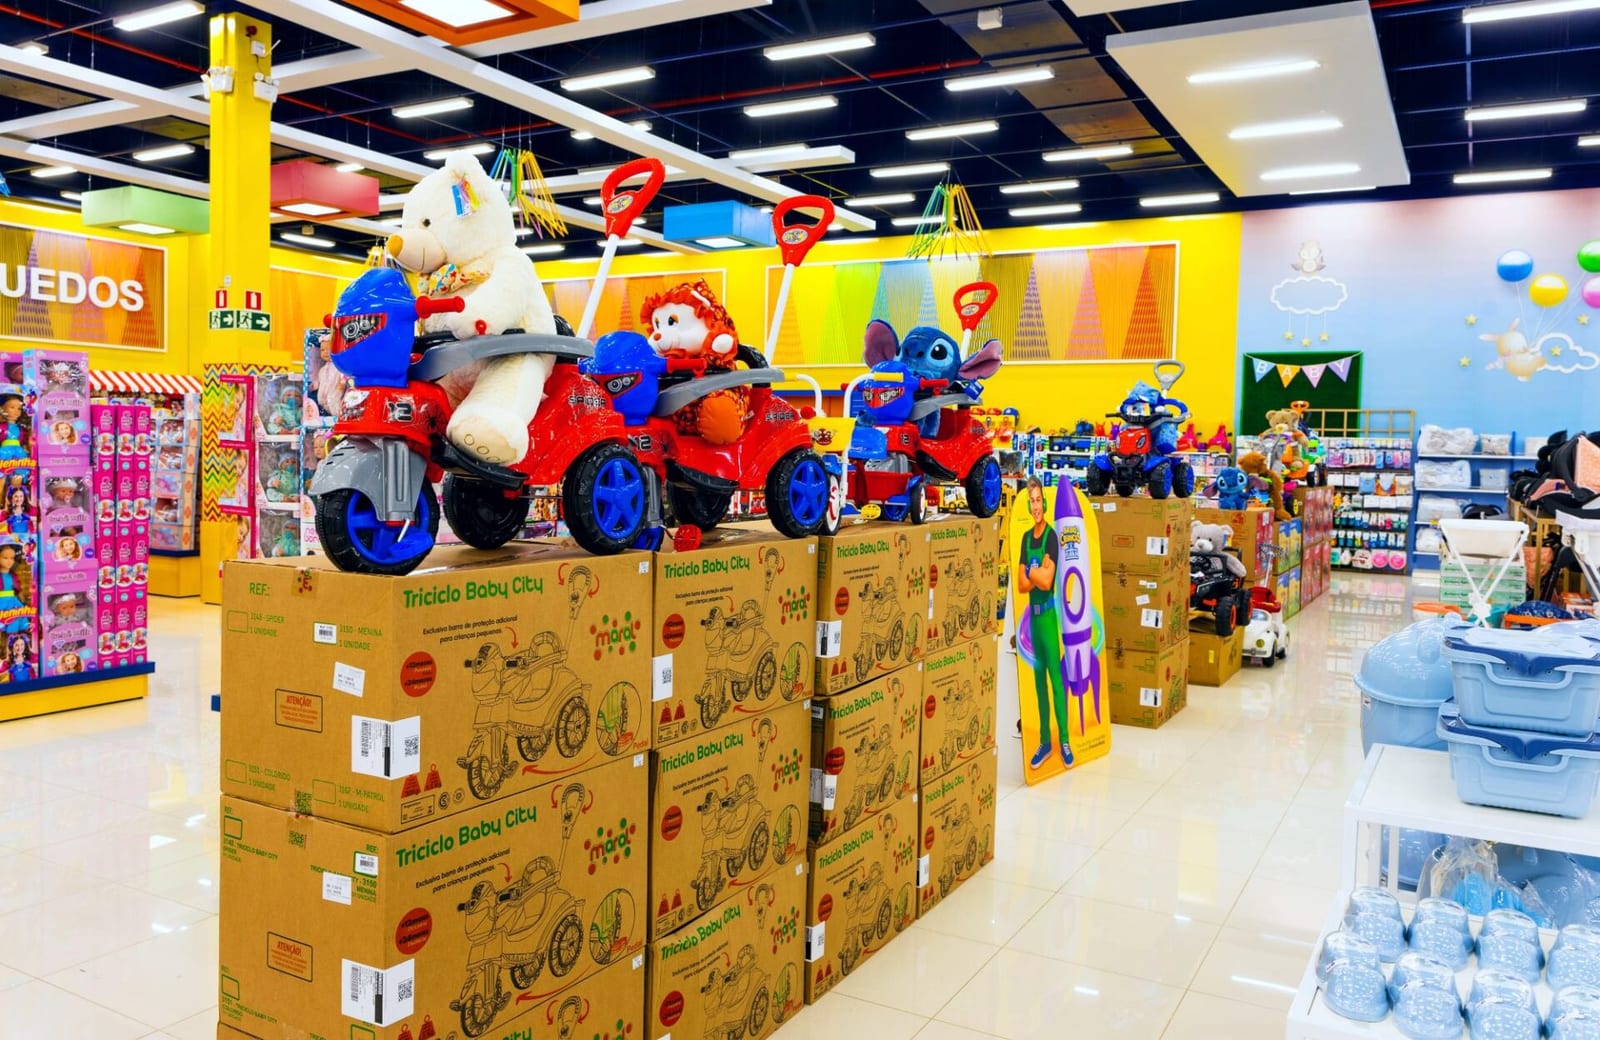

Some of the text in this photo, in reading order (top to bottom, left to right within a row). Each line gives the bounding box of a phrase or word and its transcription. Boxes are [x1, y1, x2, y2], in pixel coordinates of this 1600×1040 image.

[0, 263, 144, 312] UEDOS
[664, 556, 750, 578] Triciclo Baby City
[403, 576, 544, 608] Triciclo Baby City
[596, 623, 636, 647] maral
[661, 733, 744, 773] Triciclo Baby City
[396, 806, 537, 868] Triciclo Baby City
[590, 826, 631, 862] maral
[660, 934, 698, 961] Triciclo
[697, 918, 723, 942] Baby
